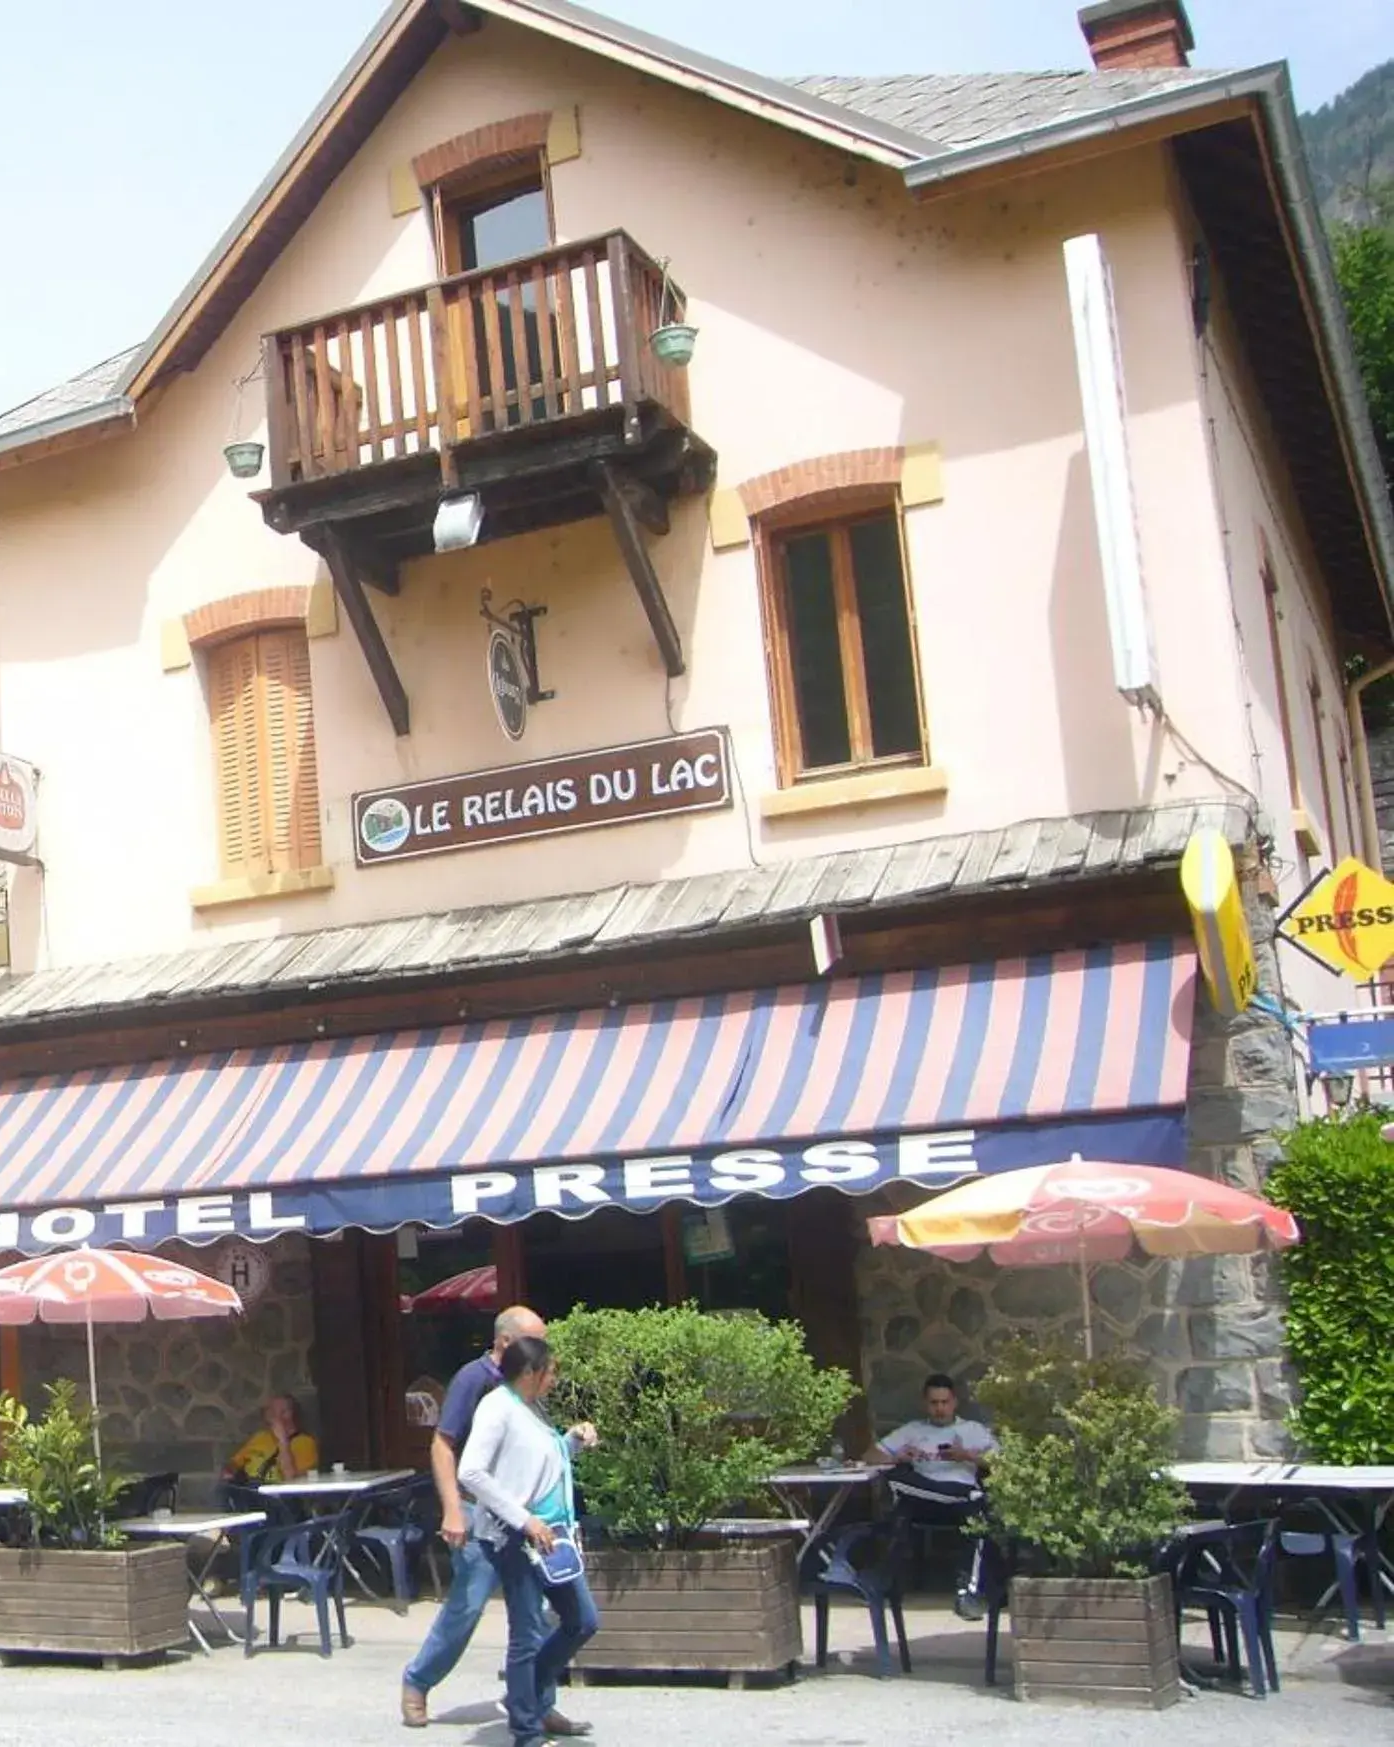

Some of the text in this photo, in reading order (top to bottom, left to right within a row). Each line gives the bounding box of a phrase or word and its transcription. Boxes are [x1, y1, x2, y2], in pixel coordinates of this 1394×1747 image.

[414, 754, 718, 835] LE RELAIS DU LAC
[450, 1129, 979, 1214] PRESSE
